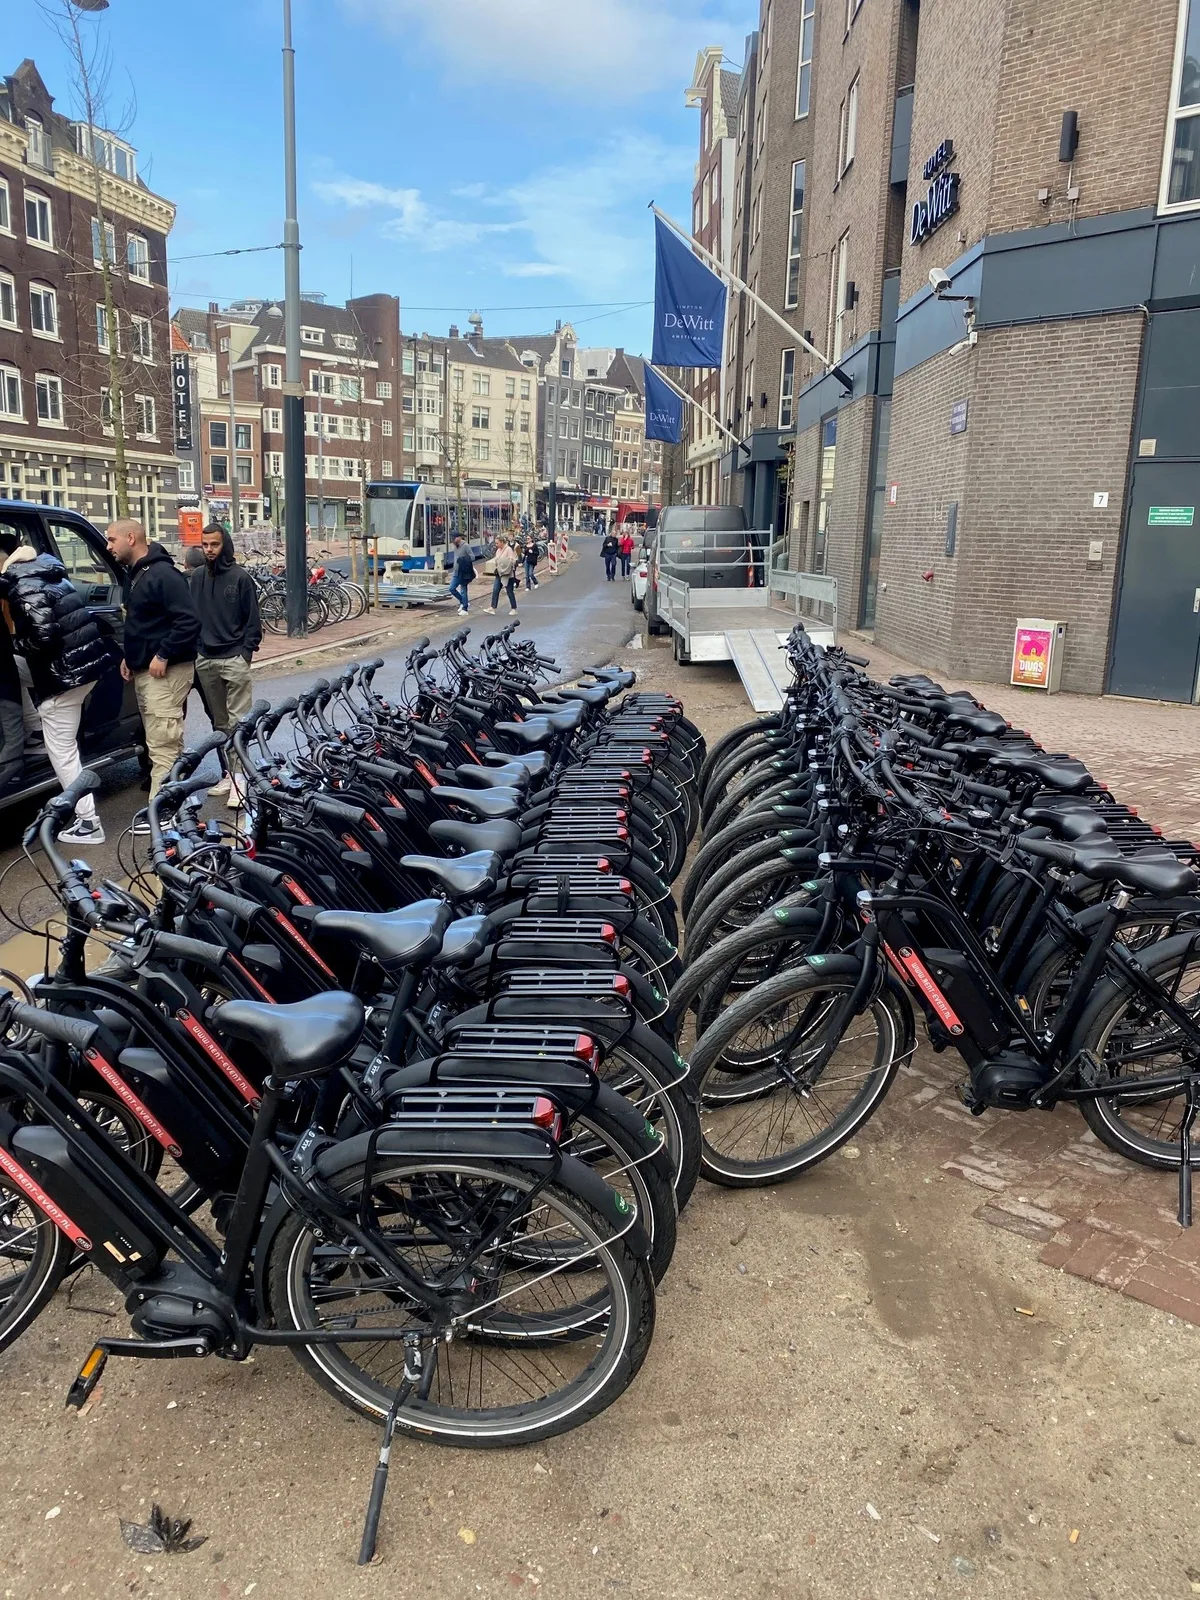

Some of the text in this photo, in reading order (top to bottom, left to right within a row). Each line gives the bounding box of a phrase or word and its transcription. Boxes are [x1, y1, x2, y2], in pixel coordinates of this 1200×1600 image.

[923, 140, 949, 178] HOTEL
[911, 173, 956, 246] DeWitt
[664, 313, 714, 330] DeWitt
[176, 356, 187, 440] HOTEL
[386, 487, 391, 496] 2
[1098, 495, 1104, 505] 7
[1019, 660, 1044, 673] DIVAS
[101, 1066, 165, 1139] WWW.RENT-EVENT.NL
